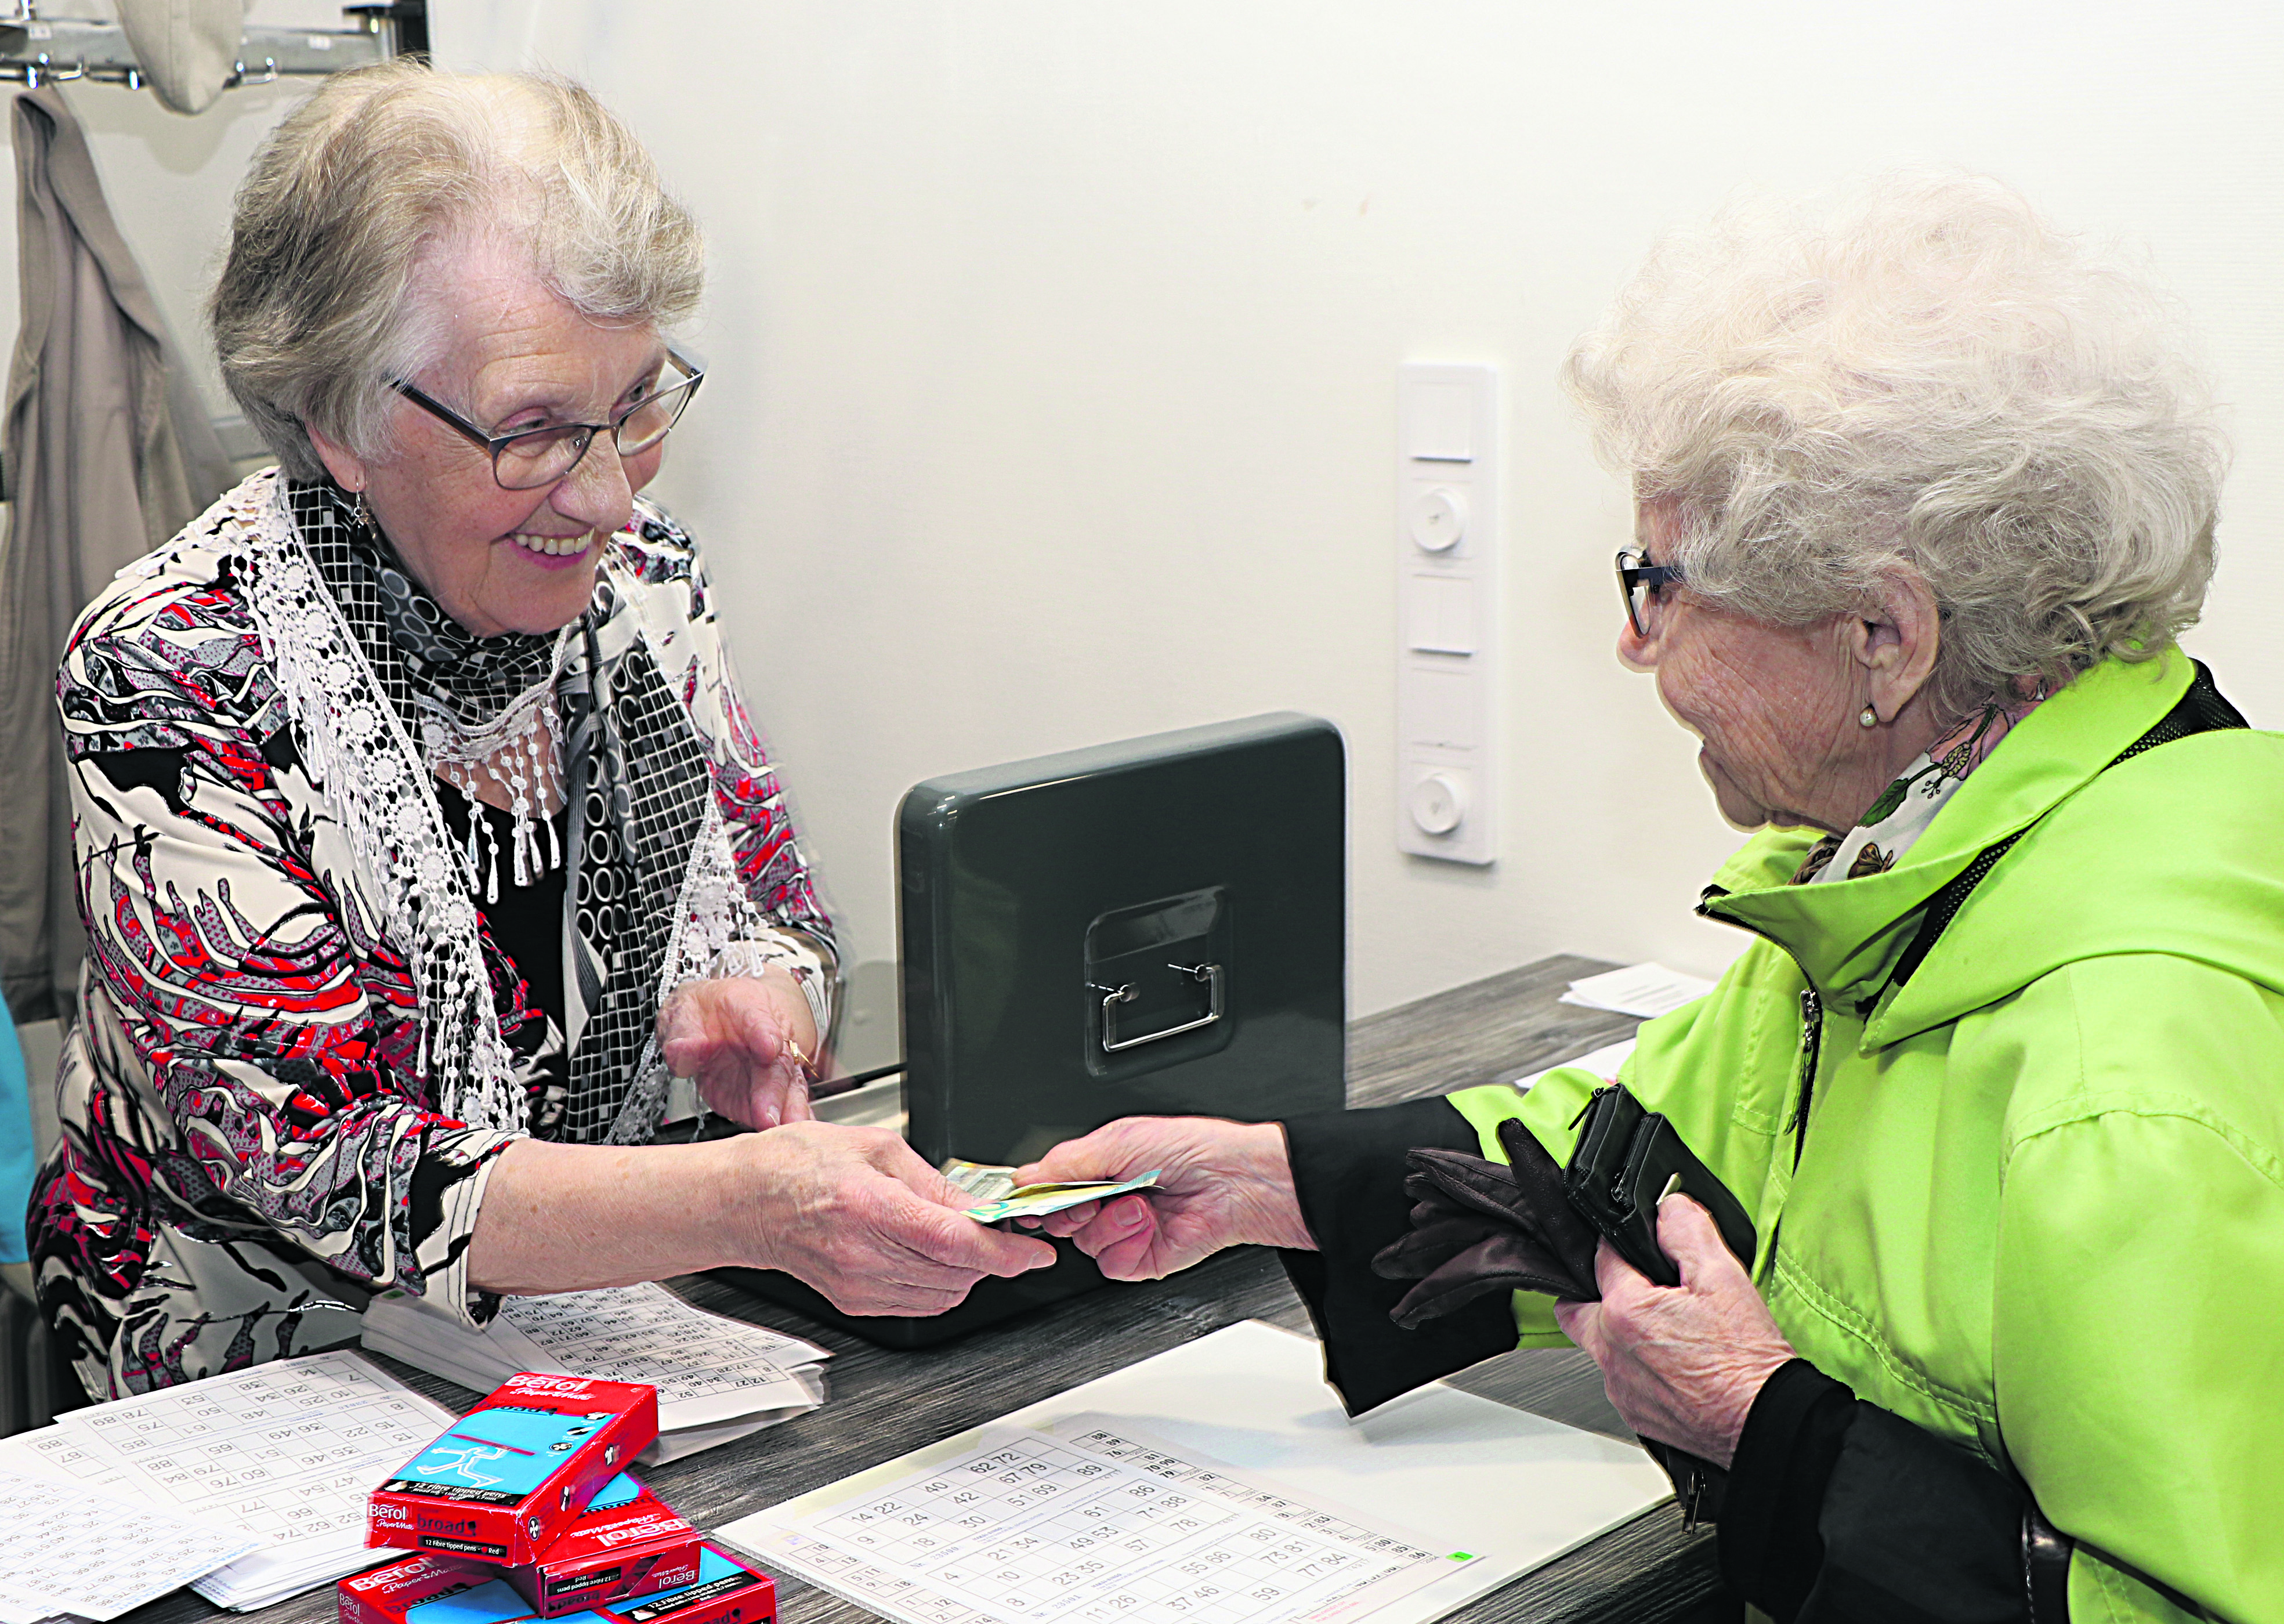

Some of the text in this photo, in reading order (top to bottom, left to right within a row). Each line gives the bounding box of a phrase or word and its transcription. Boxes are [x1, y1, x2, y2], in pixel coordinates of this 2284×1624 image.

[239, 1381, 264, 1390] 38
[505, 1375, 588, 1392] Berol
[284, 1385, 308, 1395] 26
[181, 1395, 205, 1405] 53
[255, 1392, 280, 1402] 34
[299, 1396, 324, 1406] 25
[122, 1409, 149, 1419] 78
[197, 1407, 221, 1416] 50
[241, 1410, 265, 1419] 48
[93, 1416, 116, 1426] 89
[138, 1422, 164, 1431] 75
[183, 1425, 206, 1434] 61
[147, 1404, 404, 1470] 8 36 49 65 88
[38, 1440, 62, 1450] 89
[122, 1439, 146, 1450] 85
[1105, 1450, 1121, 1458] 76
[1144, 1453, 1160, 1461] 81
[210, 1446, 358, 1488] 35 46 60 76
[1143, 1464, 1161, 1473] 70
[1159, 1470, 1175, 1479] 79
[852, 1453, 1020, 1522] 14 22 40 62 72
[857, 1463, 1047, 1545] 9 24 42 67 79
[912, 1465, 1102, 1549] 18 30 51 69 89
[369, 1504, 407, 1520] Berol
[417, 1514, 465, 1533] broad
[1314, 1516, 1331, 1524] 83
[597, 1518, 693, 1546] Berol
[944, 1485, 1155, 1580] 4 21 34 61 86
[996, 1496, 1186, 1582] 10 49 53 71 88
[1374, 1539, 1391, 1547] 80
[447, 1542, 463, 1551] tipped
[813, 1544, 830, 1552] 10
[1006, 1598, 1025, 1607] 8
[1052, 1572, 1080, 1585] 23
[1075, 1561, 1104, 1573] 35
[1124, 1539, 1149, 1551] 57
[1170, 1519, 1197, 1531] 78
[349, 1557, 436, 1592] Berol
[1085, 1607, 1111, 1619] 11
[1109, 1595, 1137, 1609] 26
[1181, 1562, 1208, 1574] 55
[1205, 1551, 1231, 1563] 66
[1250, 1529, 1276, 1540] 80
[1165, 1540, 1311, 1610] 37 46 73 81
[1251, 1553, 1348, 1600] 59 77 84
[658, 1570, 695, 1589] Berol
[340, 1593, 360, 1616] Berol
